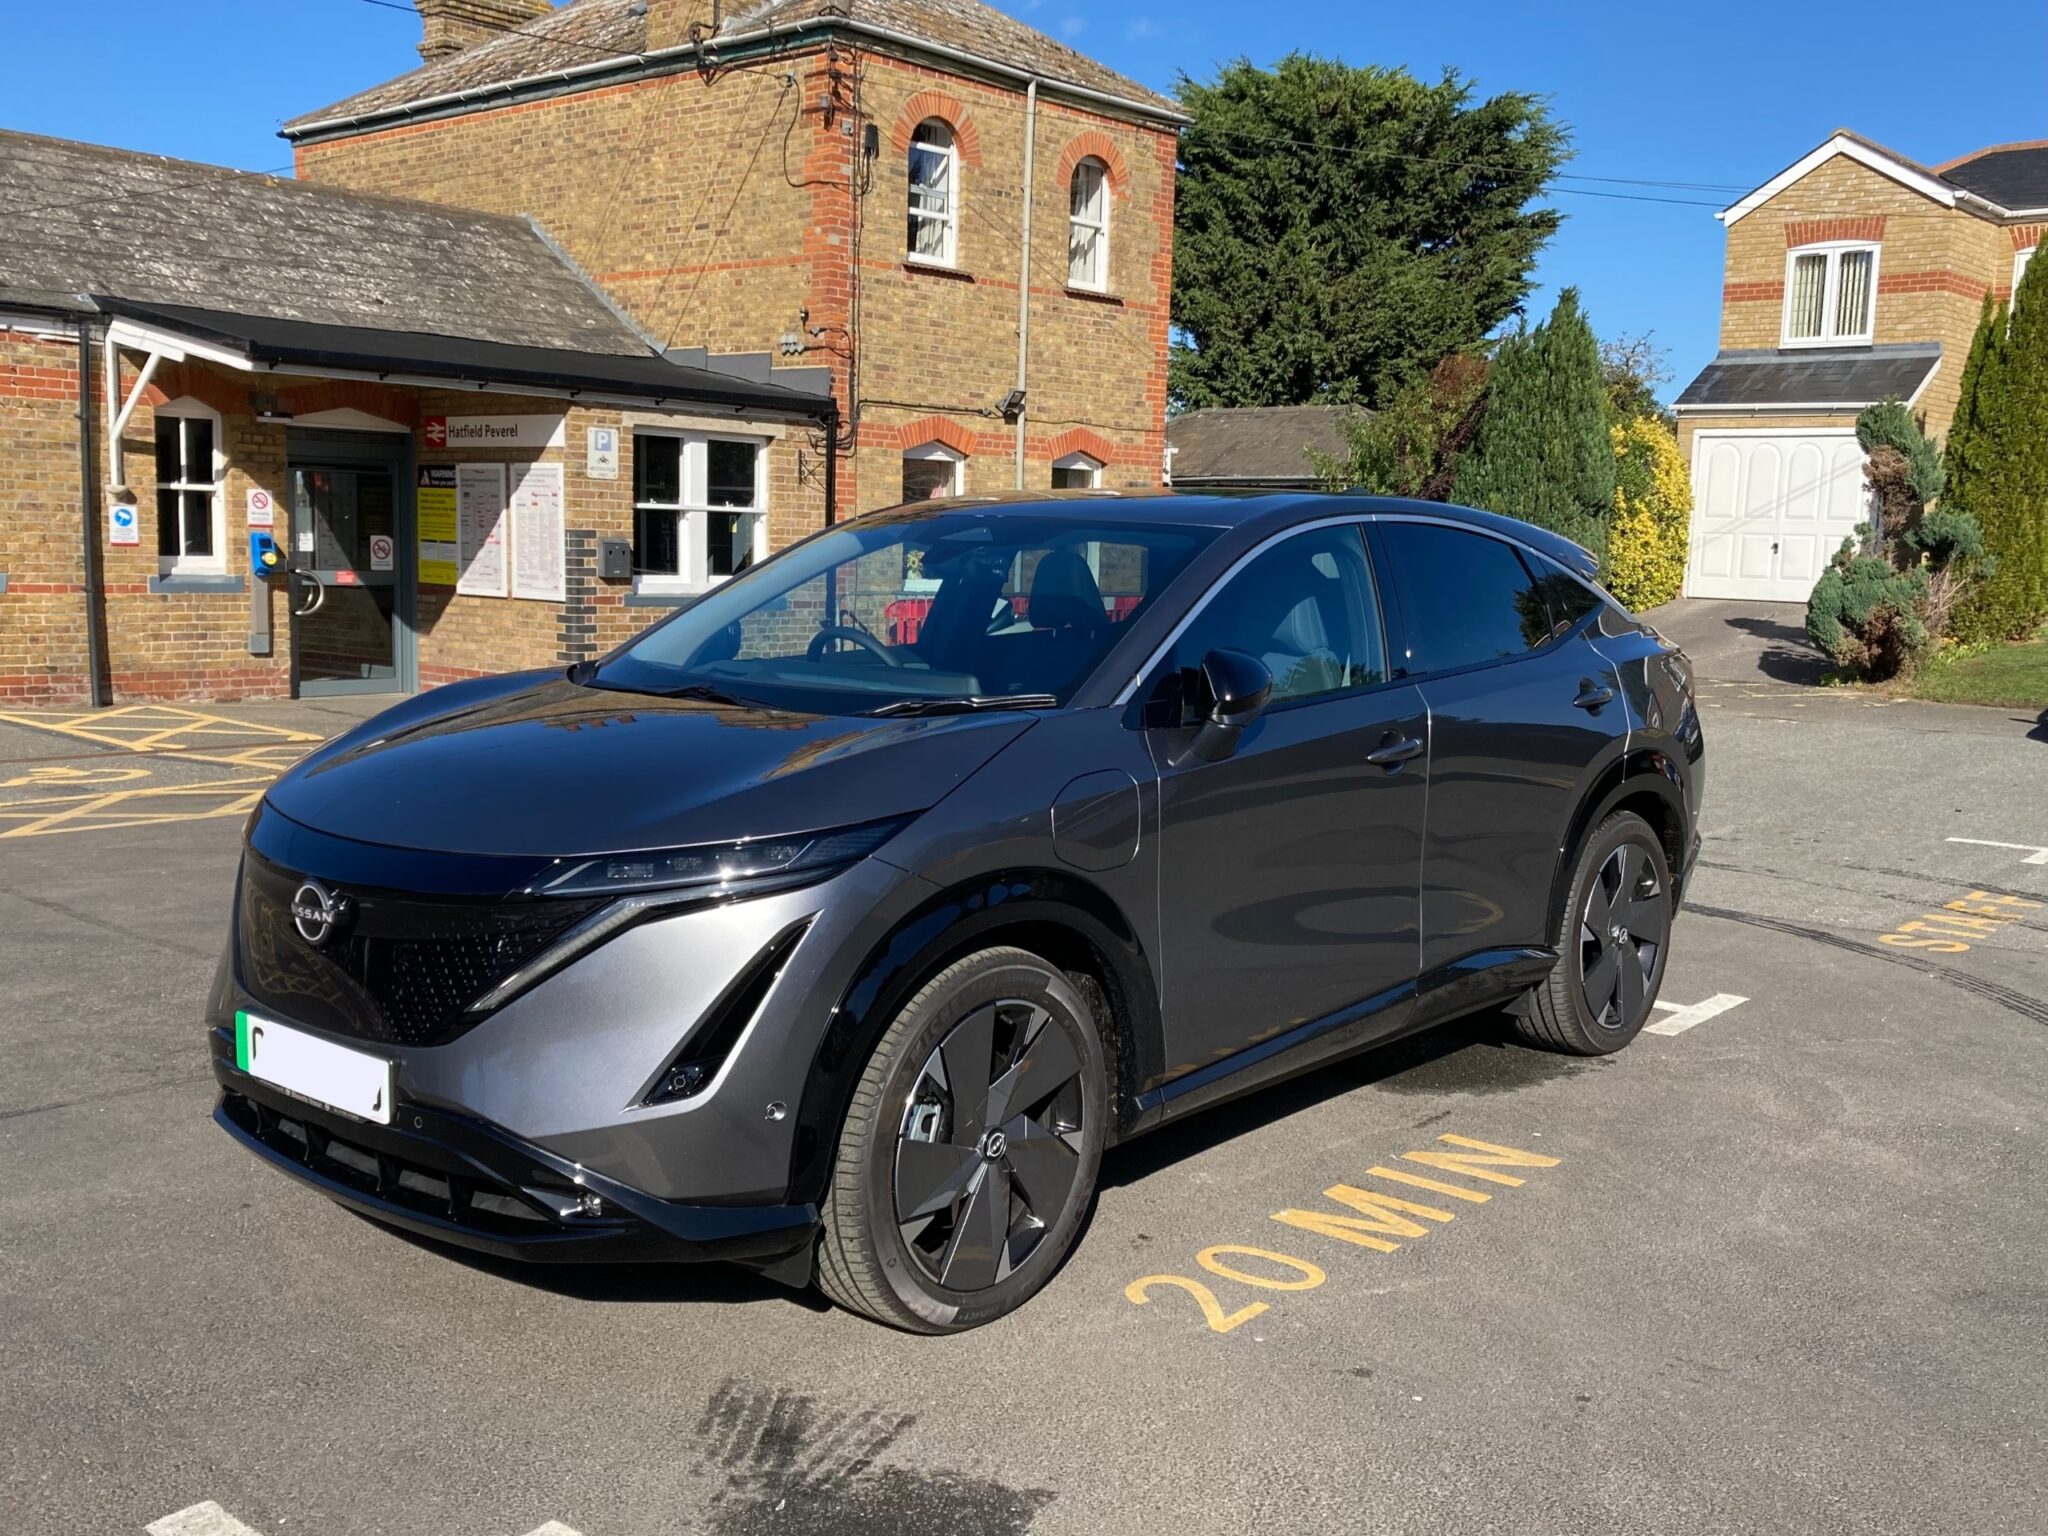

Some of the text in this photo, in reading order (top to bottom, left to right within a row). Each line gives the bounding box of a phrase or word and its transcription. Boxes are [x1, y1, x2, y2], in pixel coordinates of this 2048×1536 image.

[448, 424, 518, 439] Hatfield Peverel
[597, 431, 609, 450] P
[1877, 890, 2043, 953] STAFF
[1125, 1133, 1562, 1332] 20 MIN
